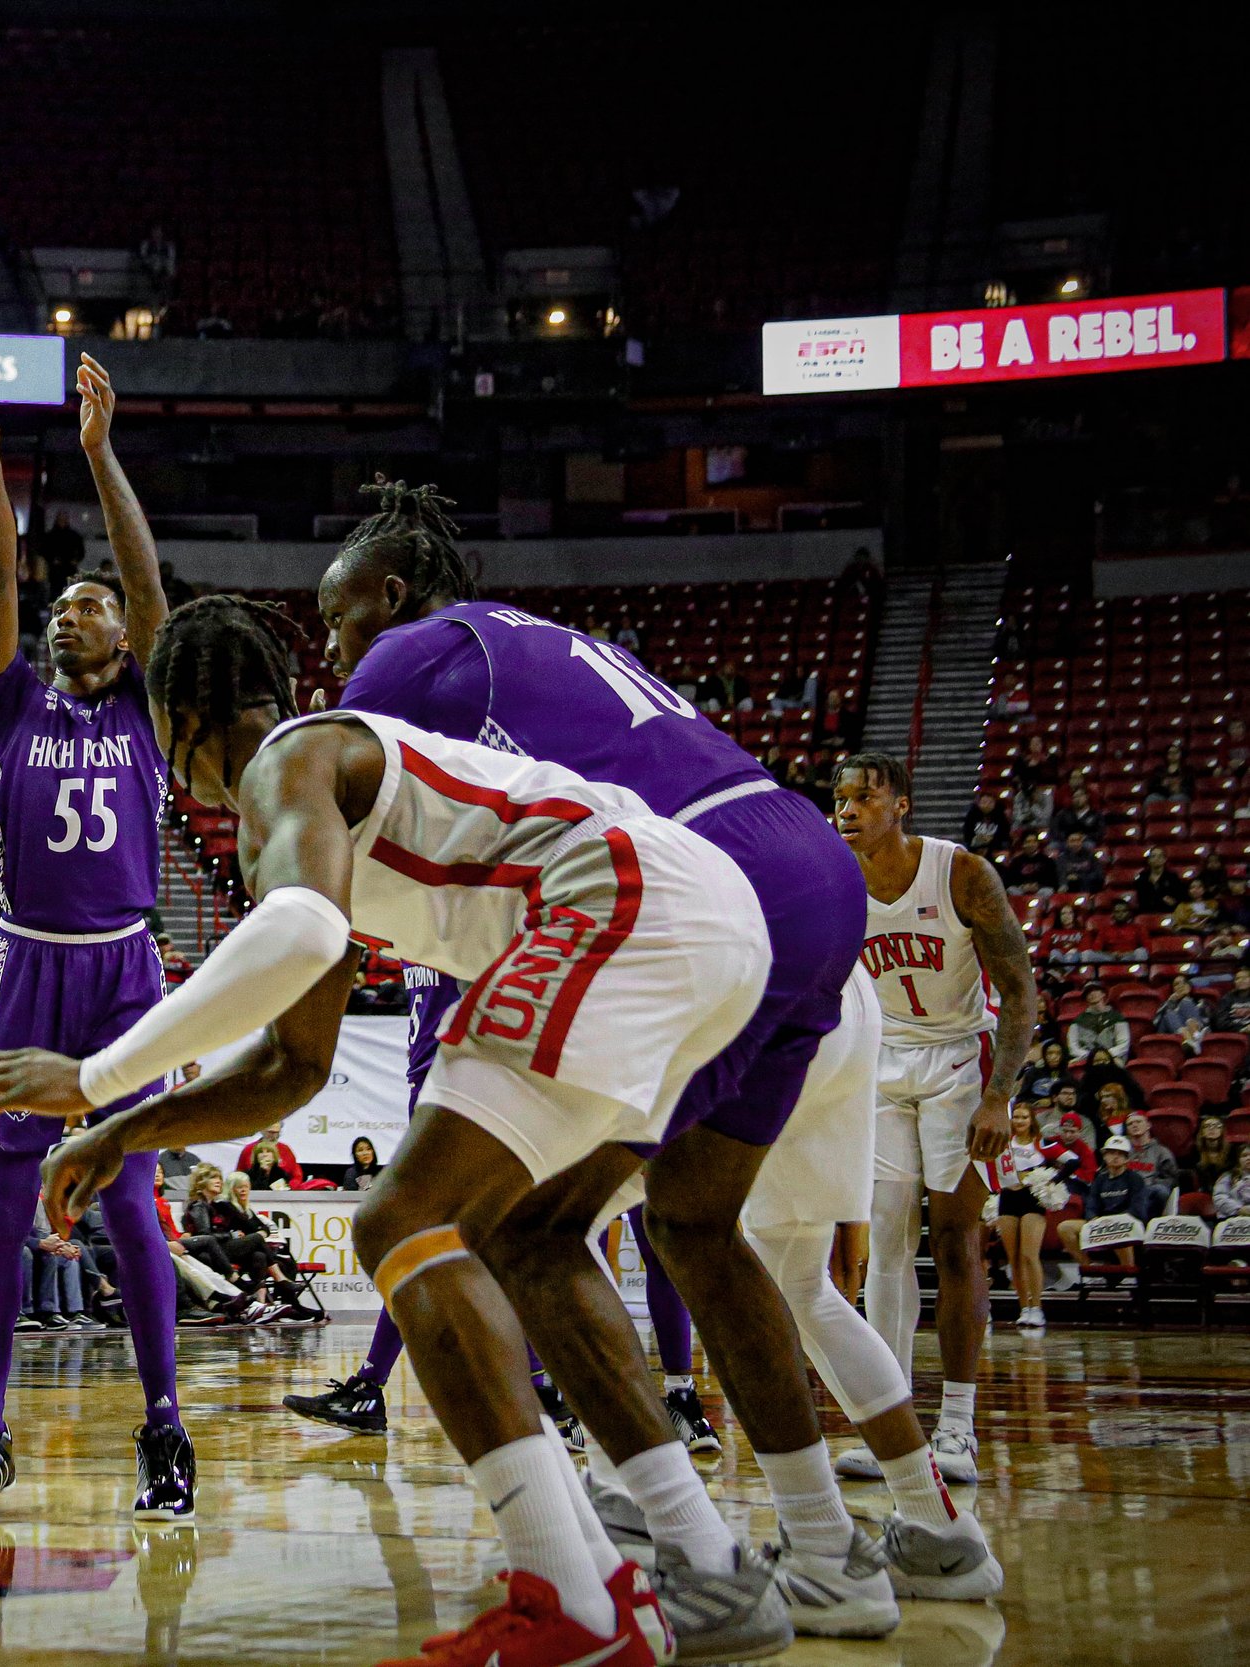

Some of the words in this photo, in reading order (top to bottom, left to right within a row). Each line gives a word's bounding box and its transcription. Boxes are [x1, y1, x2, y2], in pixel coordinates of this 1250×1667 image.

[931, 321, 985, 371] BE
[997, 318, 1034, 367] A
[1048, 304, 1196, 363] REBEL.
[27, 735, 75, 768] HIGH
[82, 735, 132, 768] POINT
[47, 777, 118, 852] 55
[477, 906, 596, 1040] UNLV
[859, 932, 945, 979] UNLV
[899, 974, 928, 1016] 1
[1089, 1222, 1134, 1236] Findlay
[1155, 1222, 1200, 1237] Findlay
